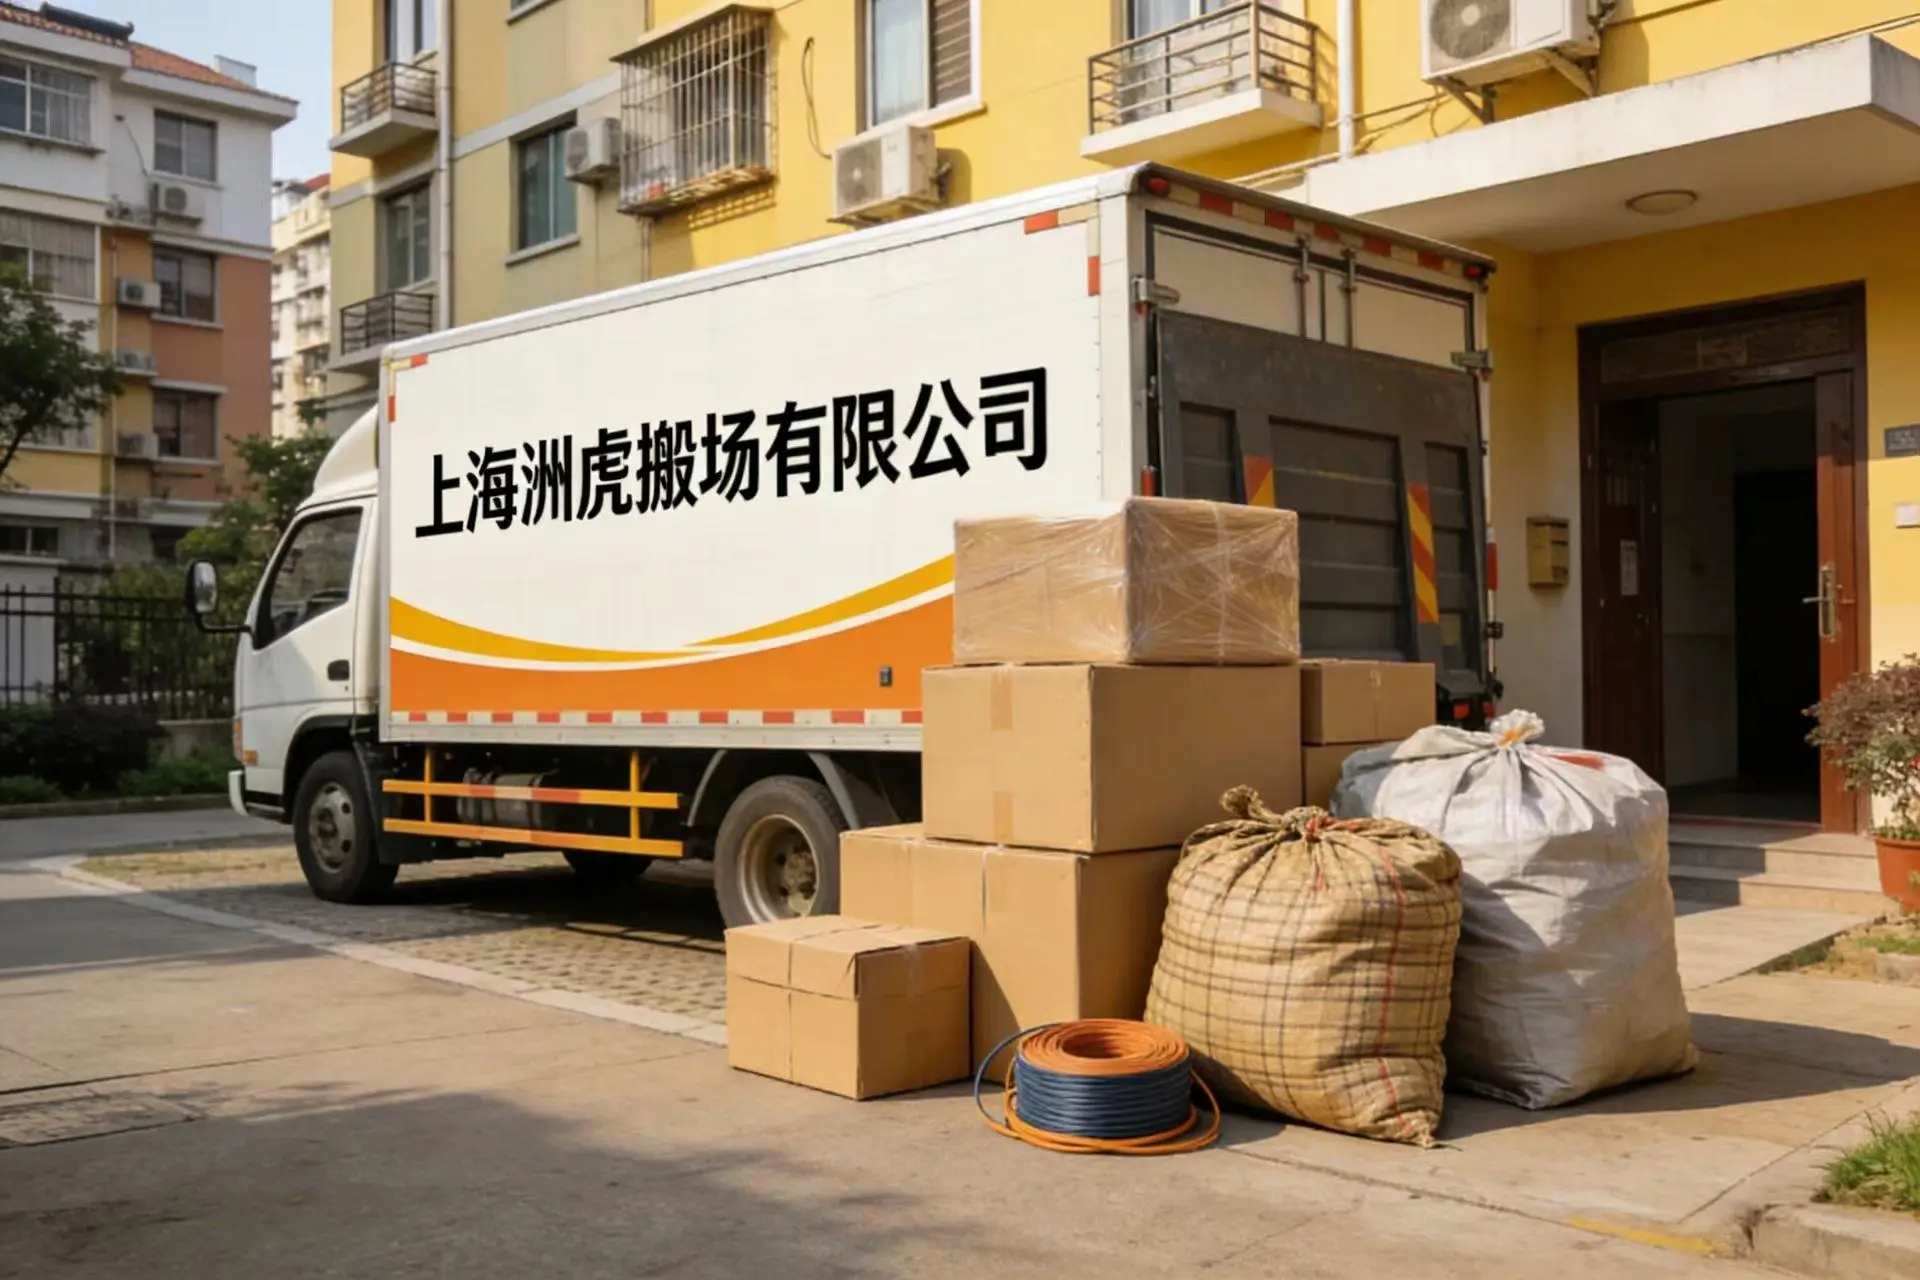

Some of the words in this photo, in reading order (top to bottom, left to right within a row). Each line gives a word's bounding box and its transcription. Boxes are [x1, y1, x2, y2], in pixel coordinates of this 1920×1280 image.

[415, 367, 1049, 538] 上海洲虎搬场有限公司
